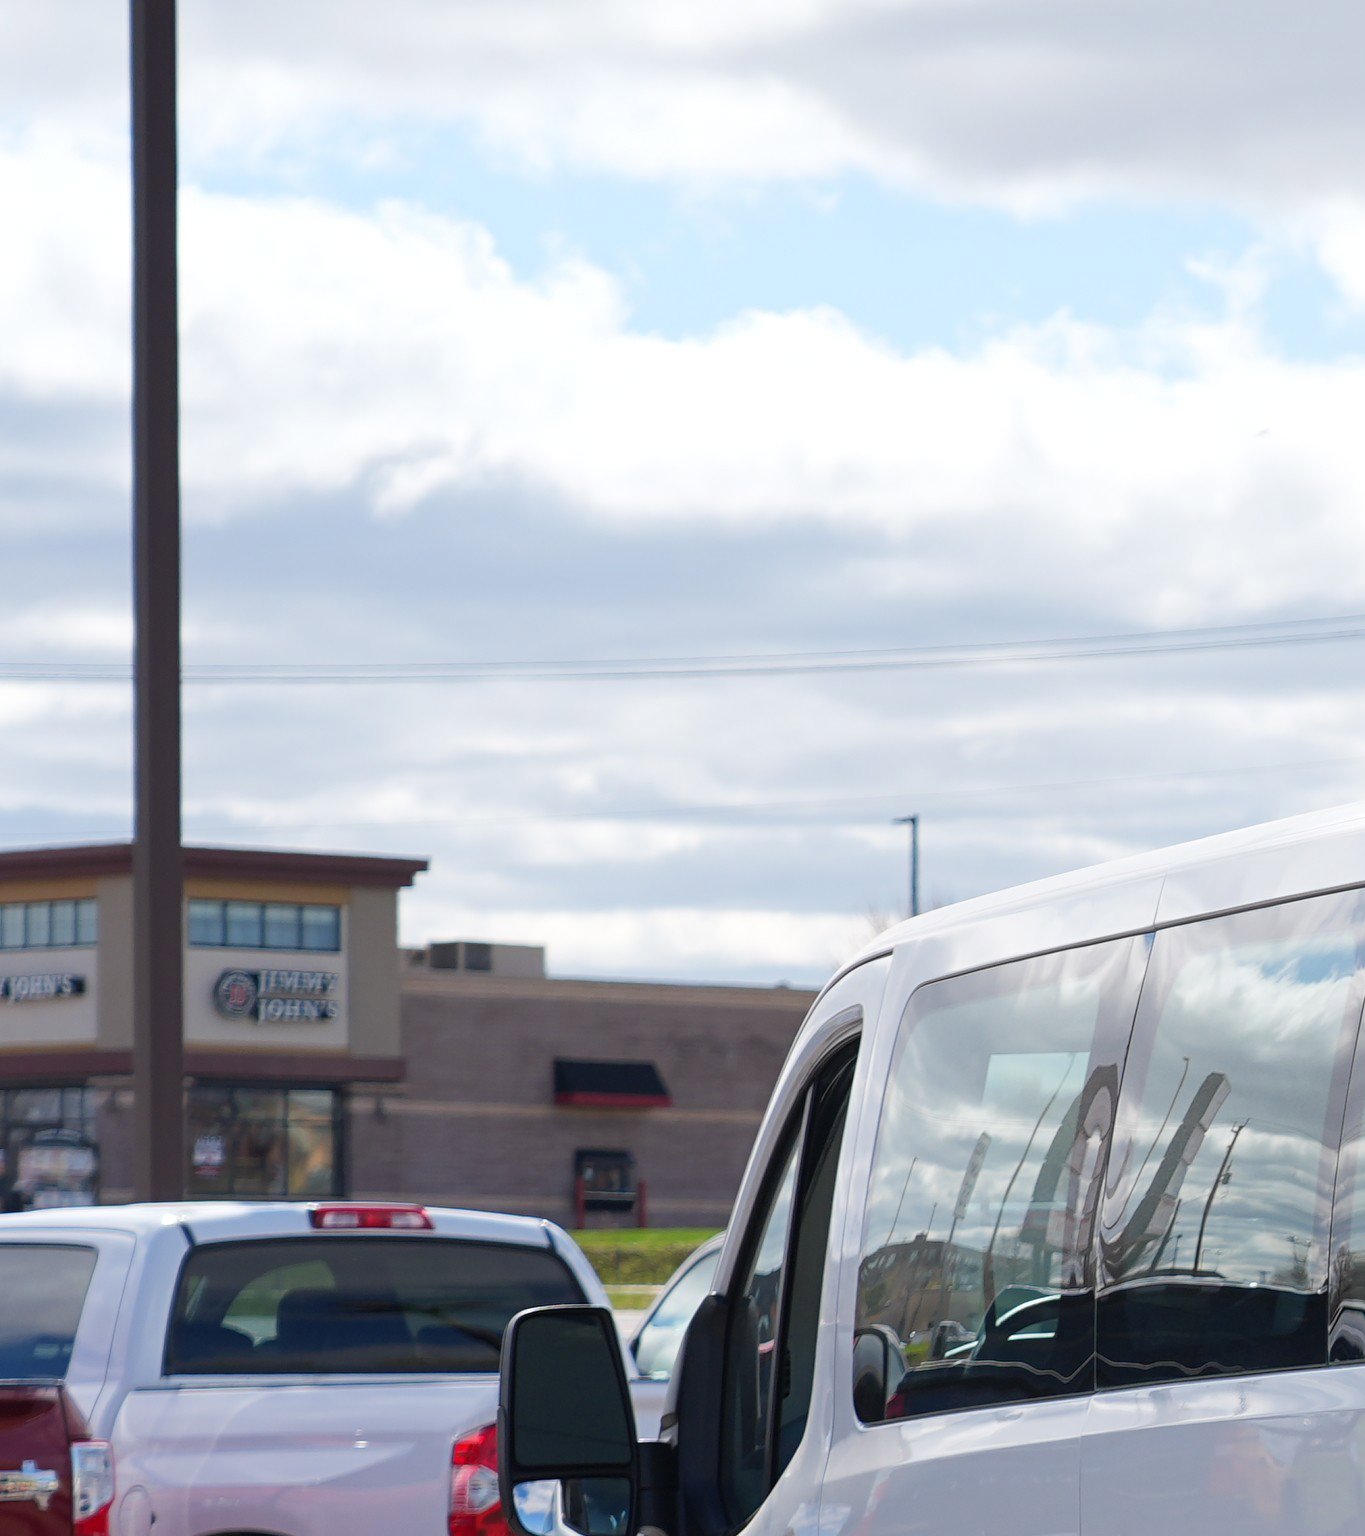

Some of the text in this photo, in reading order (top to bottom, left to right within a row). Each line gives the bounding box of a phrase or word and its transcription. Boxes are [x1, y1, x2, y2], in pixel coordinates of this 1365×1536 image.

[9, 974, 73, 1005] JOHN'S
[258, 970, 338, 993] JIMMY
[257, 998, 338, 1023] JOHN'S
